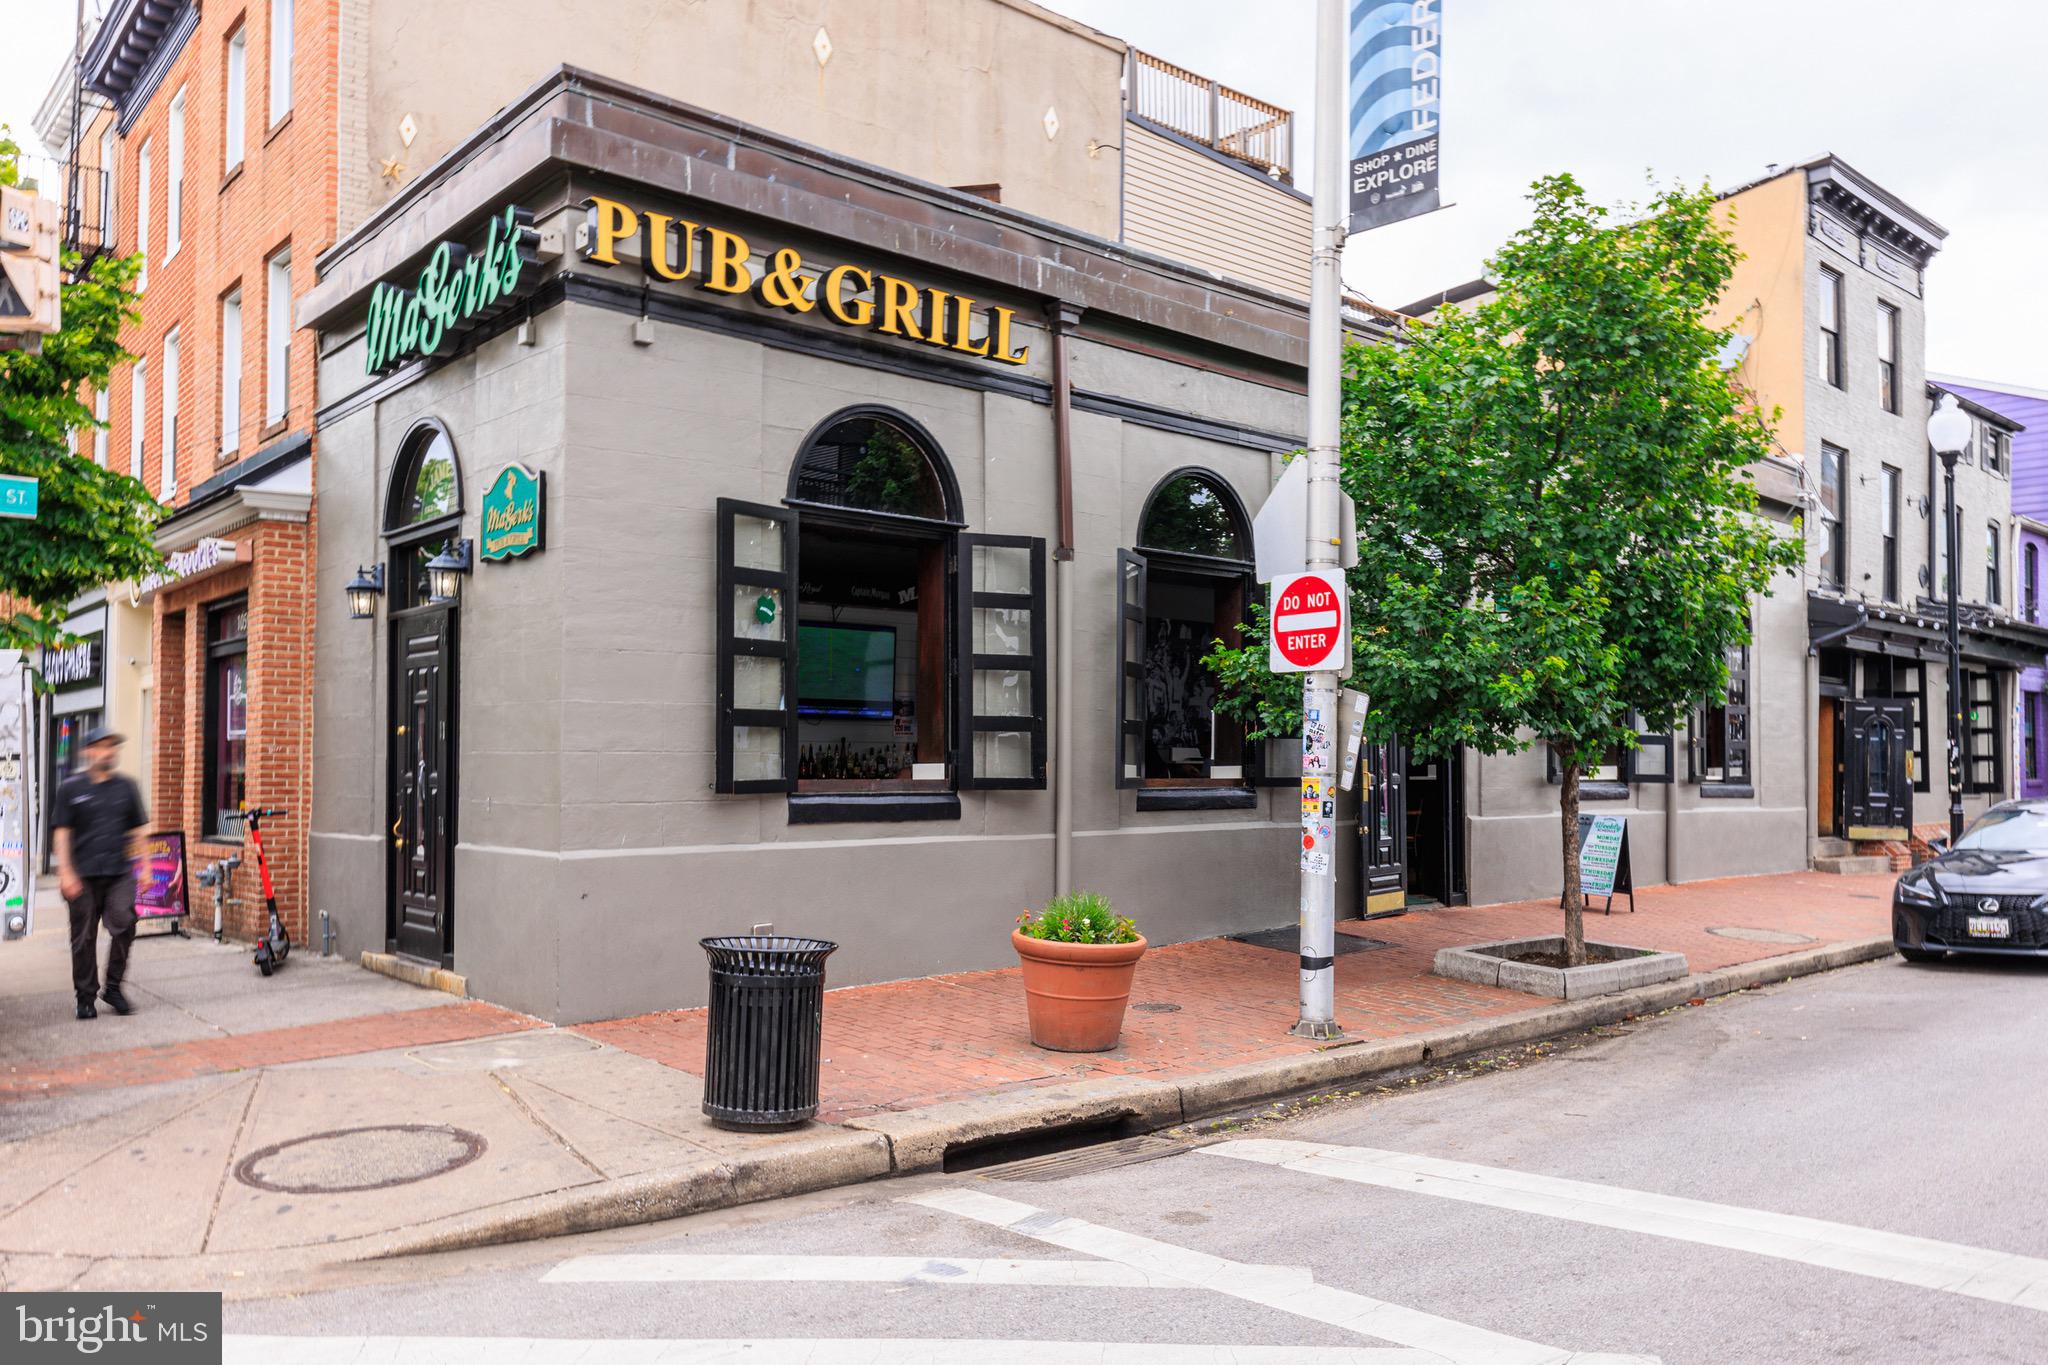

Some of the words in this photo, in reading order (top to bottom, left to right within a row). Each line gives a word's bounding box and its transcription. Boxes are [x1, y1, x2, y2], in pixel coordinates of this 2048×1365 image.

[1353, 155, 1437, 194] EXPLORE
[1354, 154, 1390, 175] SHOP
[1405, 139, 1437, 159] DINE
[366, 204, 524, 376] MaGerk's
[590, 196, 752, 295] PUB
[824, 264, 1031, 365] GRILL
[486, 498, 534, 533] MaGerk's
[1283, 595, 1300, 611] DO
[1307, 591, 1331, 608] NOT
[1287, 633, 1327, 651] ENTER
[1584, 868, 1614, 876] THURSDAY
